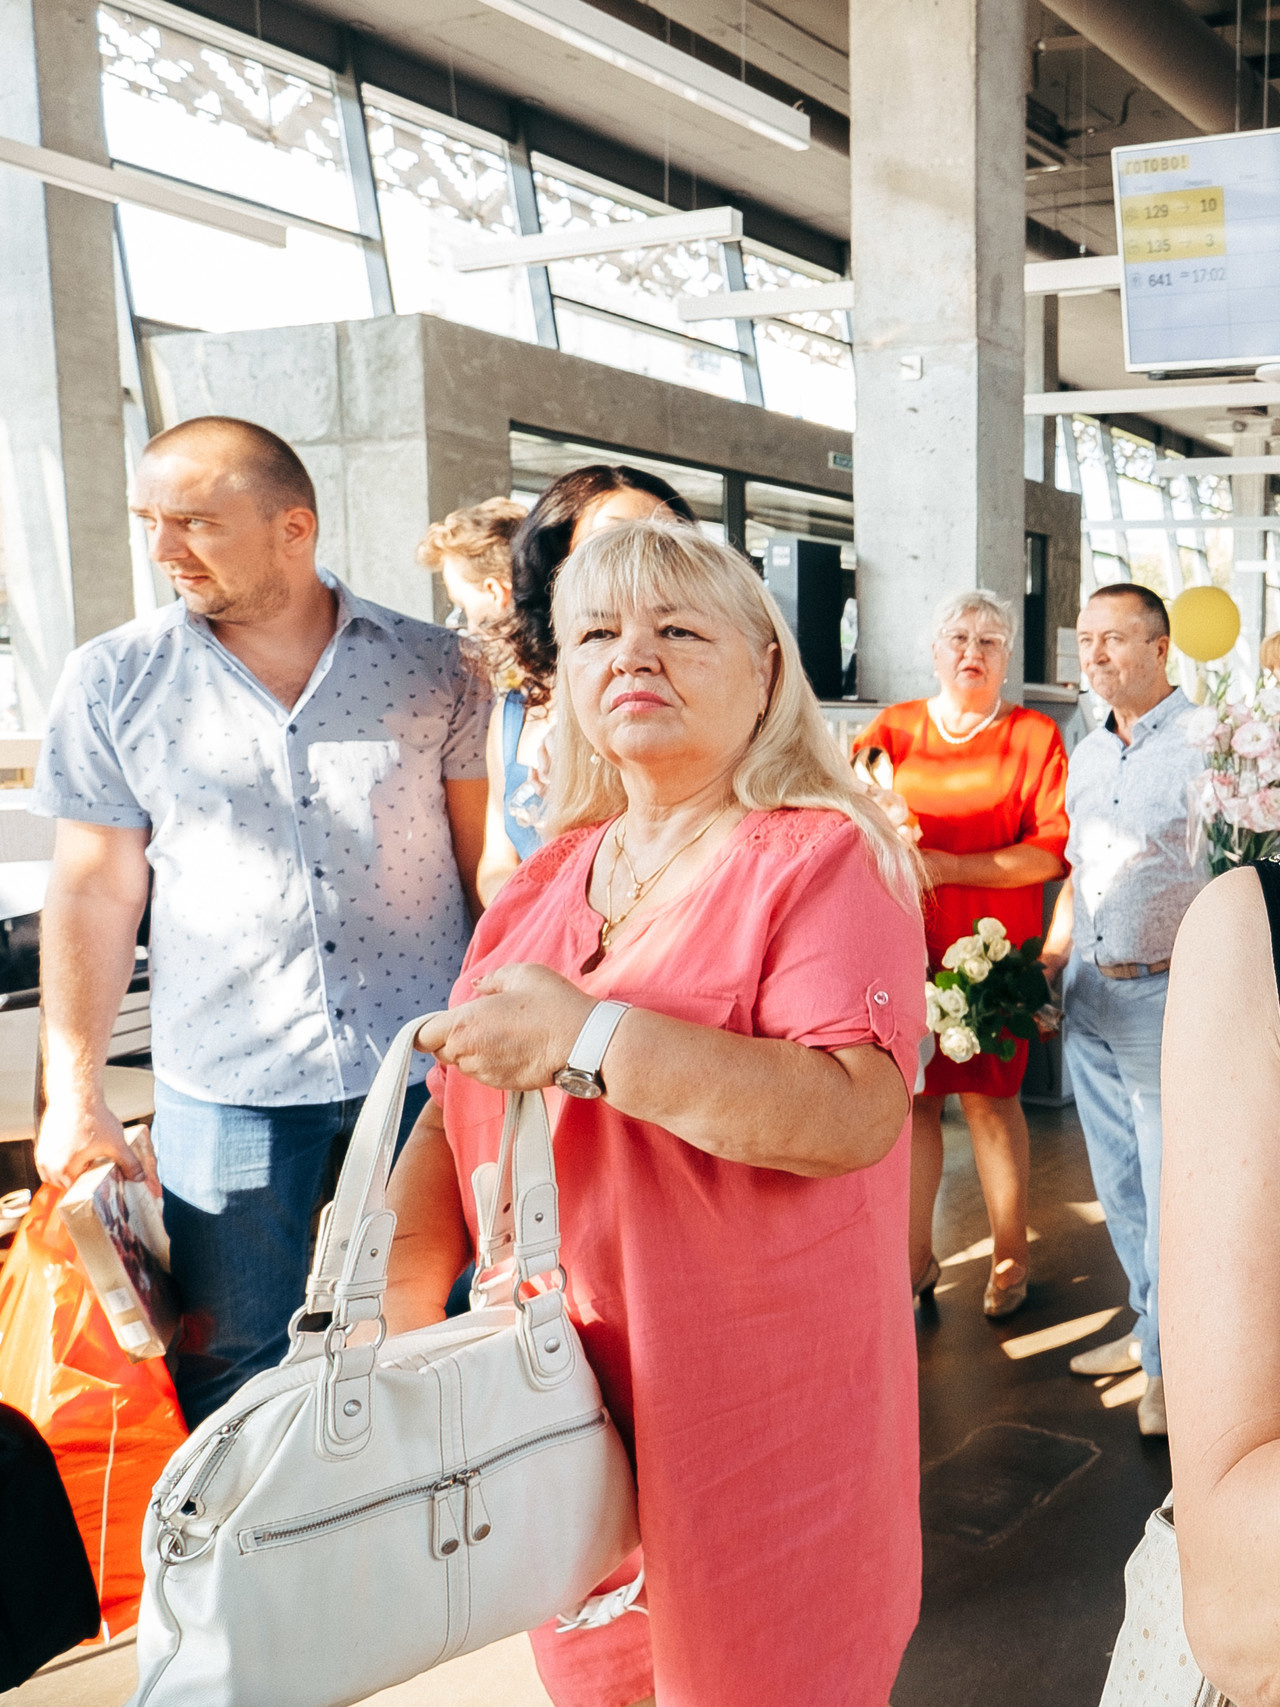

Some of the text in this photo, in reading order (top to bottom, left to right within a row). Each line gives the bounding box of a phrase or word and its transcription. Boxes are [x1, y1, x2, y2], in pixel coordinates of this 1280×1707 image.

[1125, 154, 1187, 175] ГОТОВО!
[1144, 198, 1218, 220] 129 10
[1205, 233, 1215, 247] 3
[1148, 272, 1173, 287] 641
